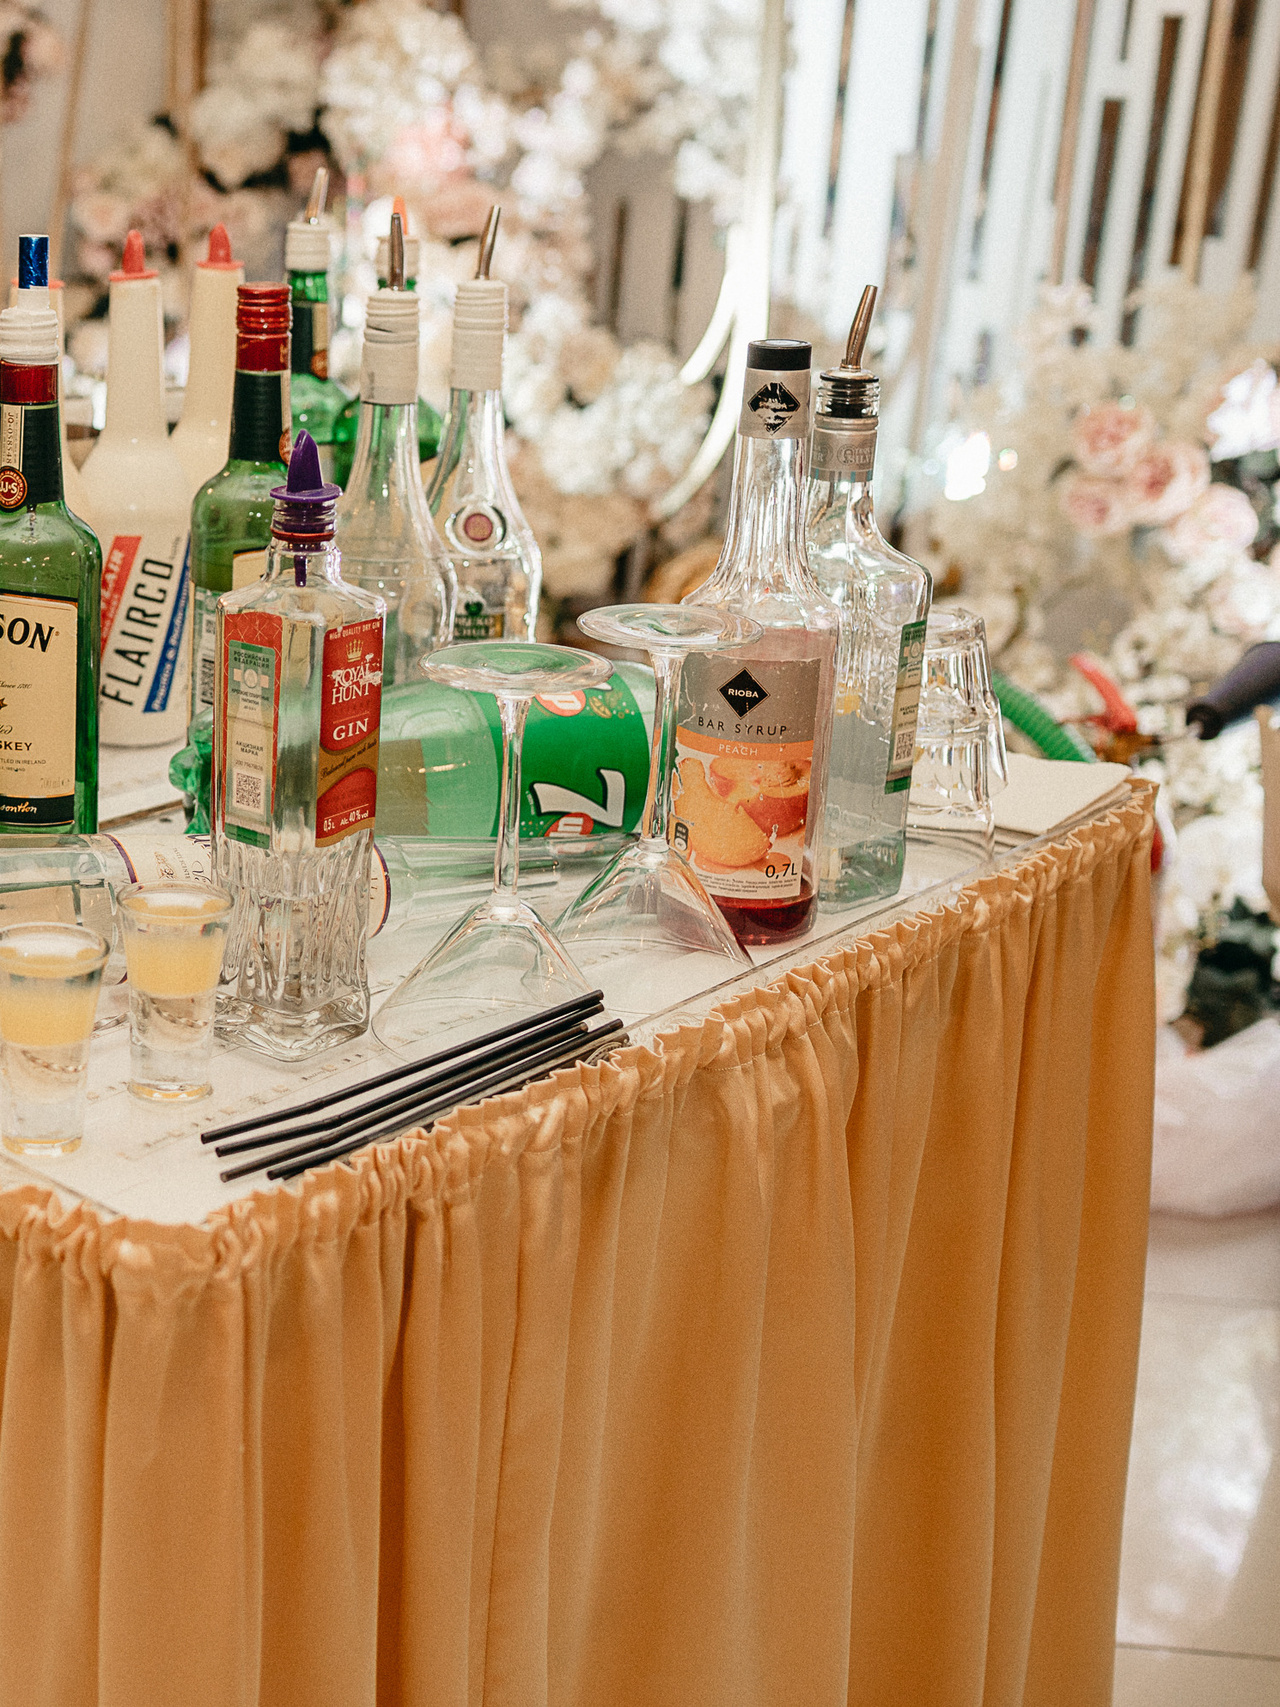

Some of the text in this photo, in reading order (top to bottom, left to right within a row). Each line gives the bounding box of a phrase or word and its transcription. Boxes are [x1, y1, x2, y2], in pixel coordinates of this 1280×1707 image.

[100, 558, 174, 707] FLAIRCO
[329, 621, 380, 640] HIGH QUALITY DRY GIN
[233, 650, 270, 663] РОССИЙСКАЯ
[233, 656, 270, 669] ФЕДЕРАЦИЯ
[333, 663, 370, 687] ROYAL
[331, 682, 369, 705] HUNT
[728, 688, 759, 699] RIOBA
[332, 717, 369, 741] GIN
[698, 716, 787, 736] BAR SYRUP
[235, 740, 264, 752] АКЦИЗНАЯ
[240, 747, 258, 757] МАРКА
[718, 744, 758, 756] PEACH
[528, 766, 626, 829] 7
[765, 862, 798, 880] 0,7L
